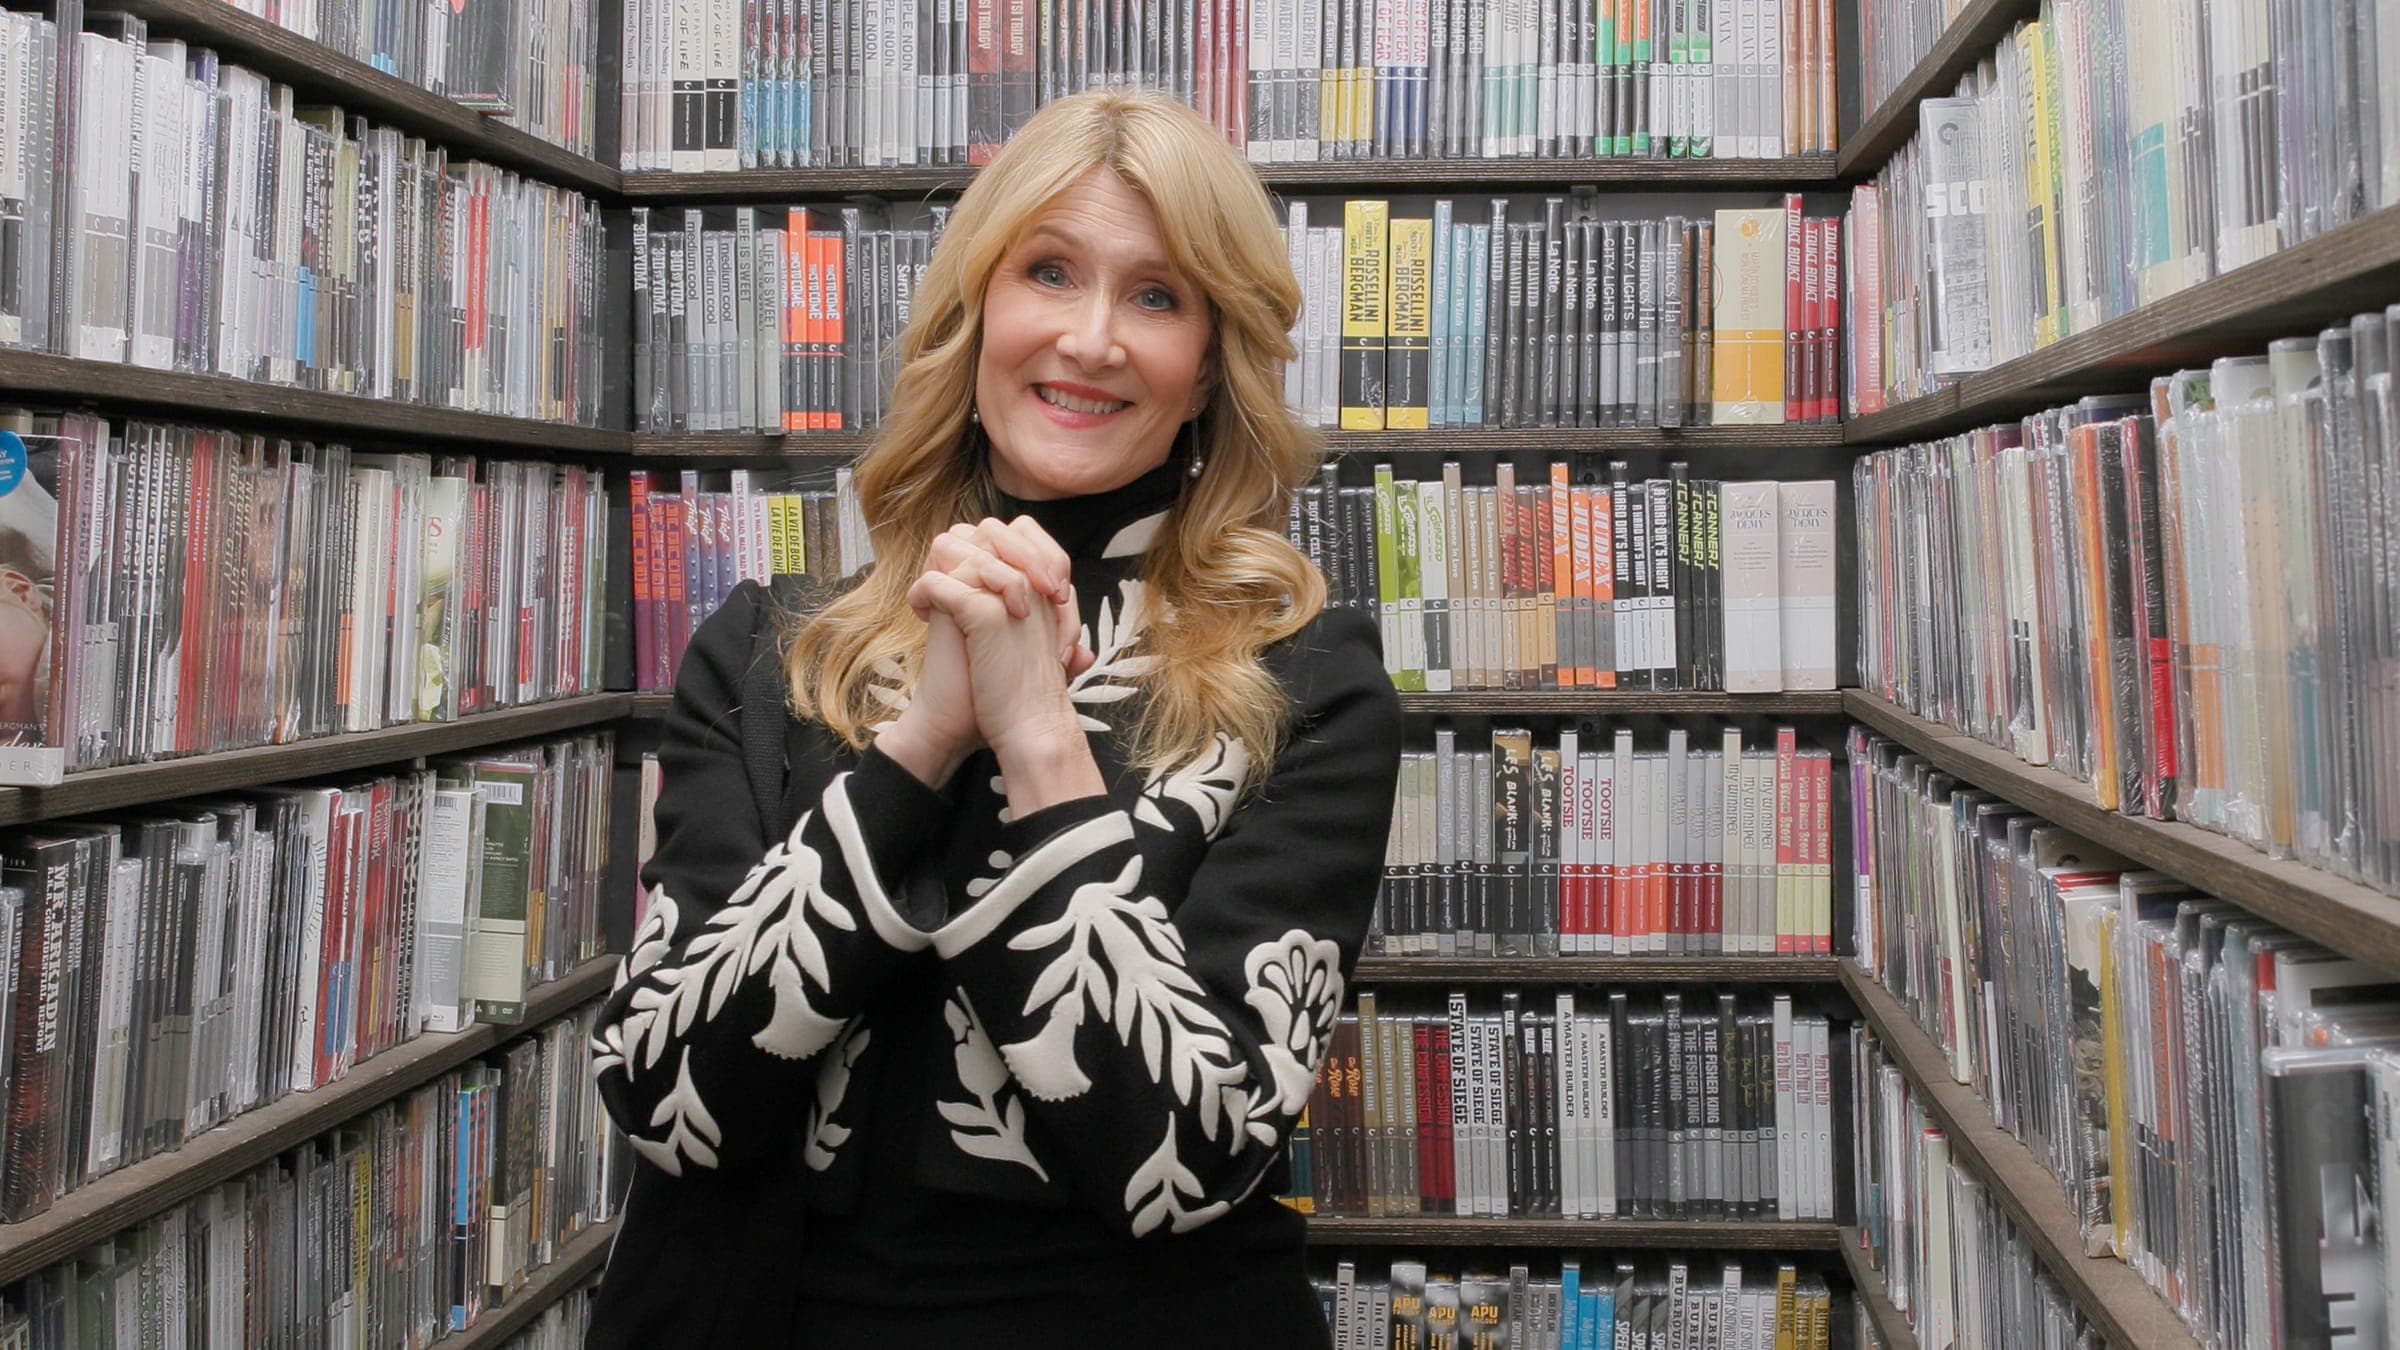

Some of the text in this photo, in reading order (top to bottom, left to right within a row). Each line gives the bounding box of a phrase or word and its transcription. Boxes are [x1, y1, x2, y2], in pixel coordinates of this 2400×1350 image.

[680, 18, 689, 70] OF LIFE
[714, 42, 722, 68] LIFE
[866, 24, 878, 60] NOON
[884, 30, 896, 67] NOON
[902, 35, 914, 72] NOON
[1376, 28, 1392, 60] FEAR
[1396, 32, 1409, 62] FEAR
[1414, 34, 1428, 62] FEAR
[1450, 8, 1465, 54] ESCAPED
[687, 222, 700, 300] medium cool
[705, 246, 718, 324] medium cool
[721, 243, 734, 321] medium cool
[739, 218, 752, 303] LIFE IS SWEET
[762, 243, 776, 330] LIFE IS SWEET
[1349, 257, 1364, 322] BERGMAN
[1364, 250, 1380, 322] ROSSELLINI
[1550, 240, 1562, 293] La Notte
[1566, 260, 1578, 310] La Notte
[1603, 238, 1615, 322] CITY LIGHTS
[1624, 236, 1635, 321] CITY LIGHTS
[1638, 251, 1656, 329] Frances Ha
[1664, 243, 1681, 322] Frances Ha
[1806, 228, 1818, 304] TOUKI BOUKI
[1394, 267, 1410, 332] BERGMAN
[1410, 258, 1424, 332] ROSSELLINI
[126, 442, 138, 502] YOUTH
[136, 442, 148, 502] YOUTH
[171, 457, 181, 504] CASQUE
[184, 458, 193, 505] CASQUE
[224, 451, 239, 581] NIGHT CITY
[772, 506, 783, 547] LA VIE DE
[788, 506, 800, 546] LA VIE DE
[1308, 500, 1319, 522] RIOT
[1310, 525, 1320, 536] IN
[1552, 475, 1570, 559] JUDEX
[1614, 490, 1627, 518] HARD
[1614, 520, 1628, 549] DAY'S
[1677, 480, 1690, 566] SCANNERS
[1692, 490, 1704, 571] SCANNERS
[230, 480, 246, 610] NIGHT CITY
[239, 481, 254, 610] NIGHT CITY
[1518, 505, 1534, 592] RED RIVER
[1573, 501, 1591, 586] JUDEX
[1615, 550, 1629, 582] NIGHT
[1632, 512, 1646, 586] HARD DAY'S NIGHT
[1503, 748, 1519, 774] LES
[1562, 766, 1574, 828] TOOTSIE
[1581, 778, 1594, 840] TOOTSIE
[1600, 778, 1612, 840] TOOTSIE
[36, 908, 52, 1053] CONFIDENTIAL REPORT
[44, 862, 68, 1051] MR. ARKADIN
[1450, 1002, 1468, 1124] STATE OF SIEGE
[1470, 1026, 1485, 1124] STATE OF SIEGE
[1488, 1028, 1503, 1125] STATE OF SIEGE
[1565, 1070, 1575, 1118] BUILDER
[1668, 1032, 1683, 1101] FISHER KING
[1686, 1054, 1701, 1124] FISHER KING
[1582, 1080, 1590, 1120] BUILDER
[1338, 1280, 1350, 1326] In Cold
[1356, 1300, 1368, 1345] In Cold
[1428, 1306, 1456, 1319] APU
[1546, 1304, 1557, 1332] DYLAN
[1724, 1287, 1736, 1306] LADY
[1740, 1311, 1754, 1330] LADY
